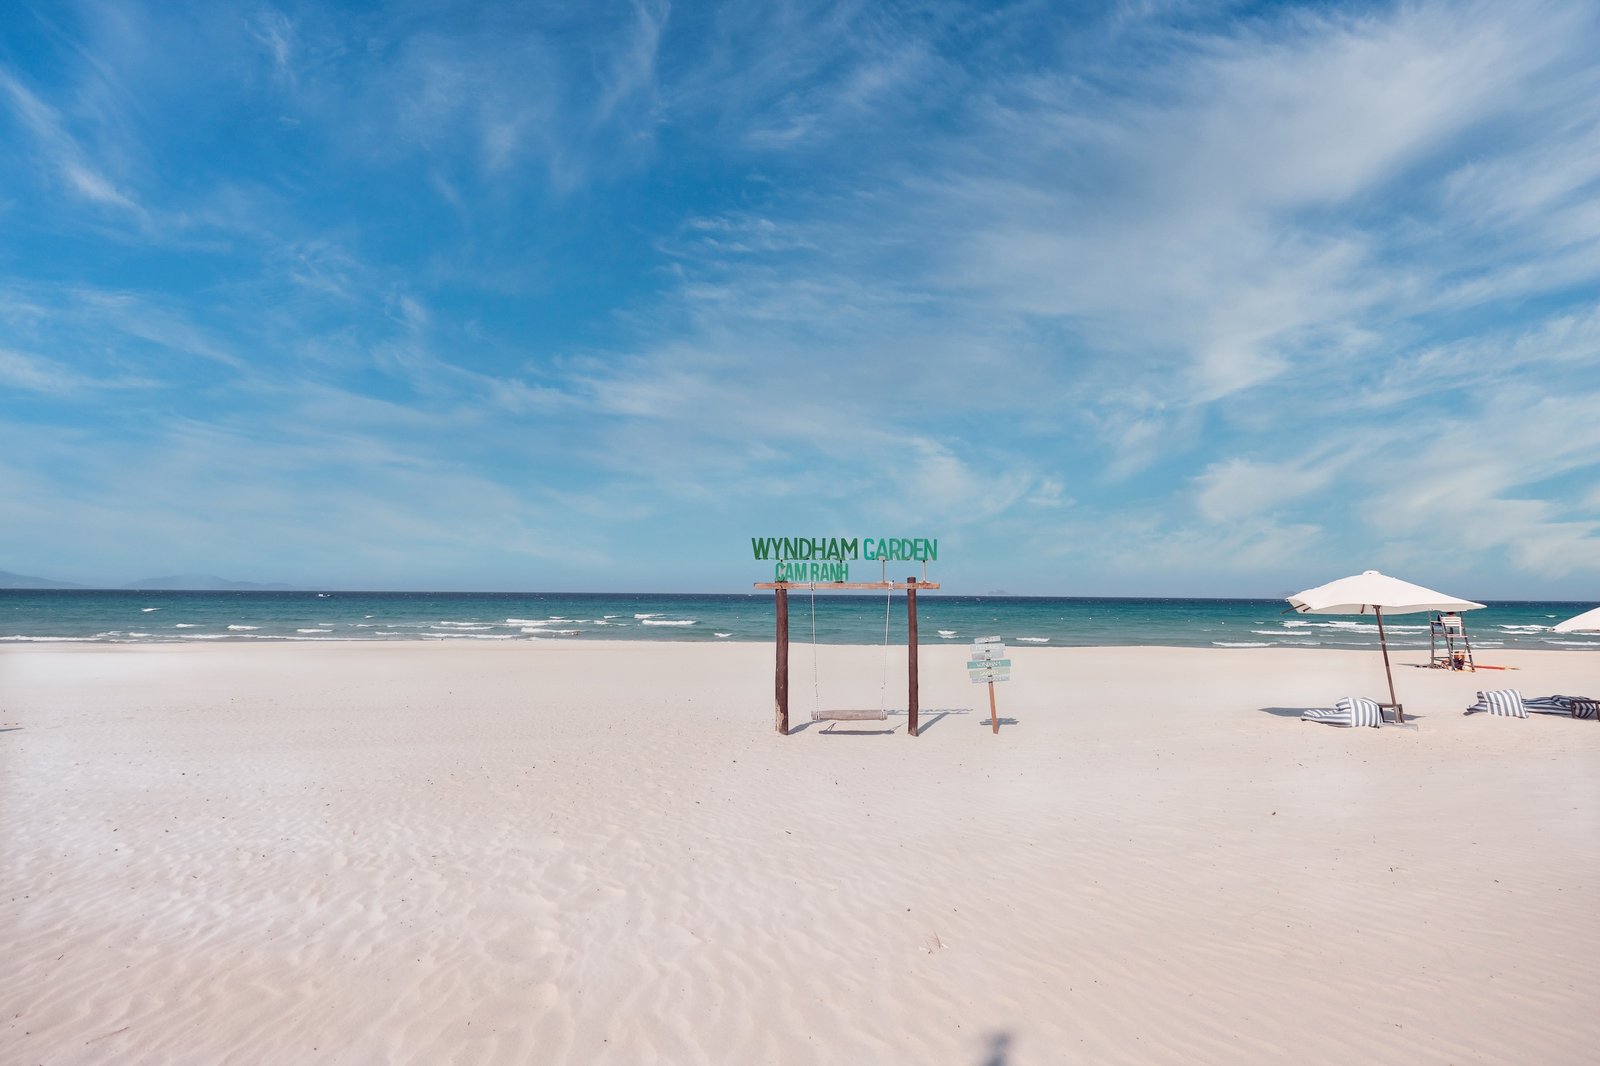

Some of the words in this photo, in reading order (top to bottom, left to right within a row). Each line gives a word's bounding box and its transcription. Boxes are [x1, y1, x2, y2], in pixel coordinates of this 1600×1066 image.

[752, 537, 858, 560] WYNDHAM
[863, 538, 938, 561] GARDEN
[775, 562, 807, 581] CAM
[811, 562, 849, 581] RANH
